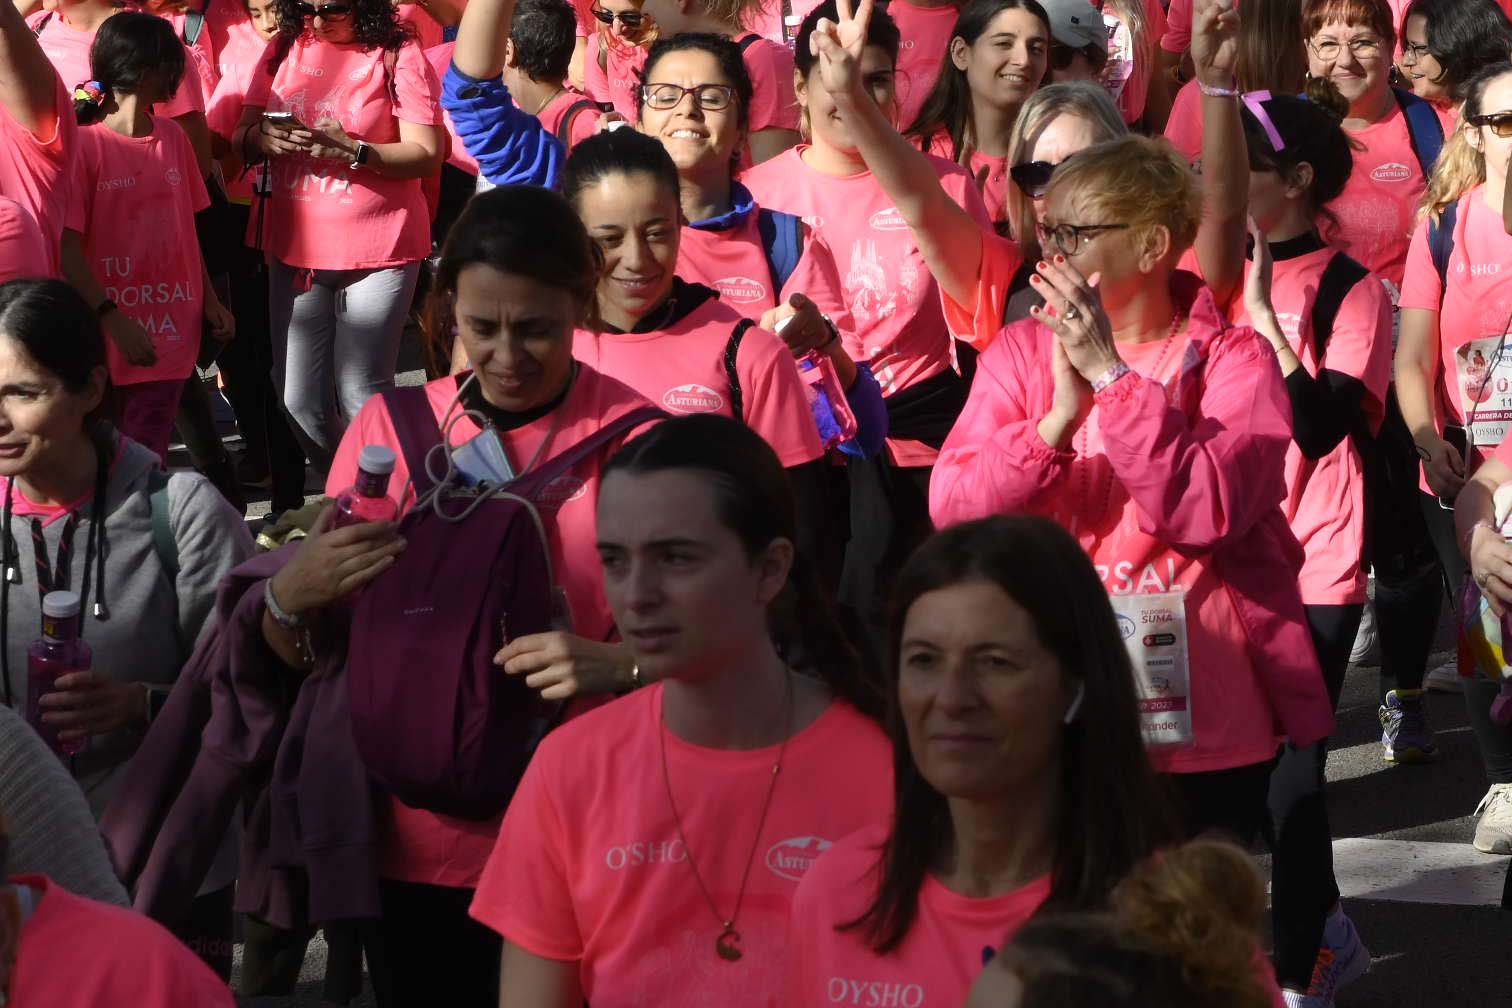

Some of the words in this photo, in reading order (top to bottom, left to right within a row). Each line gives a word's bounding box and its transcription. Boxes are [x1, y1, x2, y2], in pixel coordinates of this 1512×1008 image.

[1374, 170, 1410, 179] ASTURIANA
[101, 256, 132, 278] TU
[664, 392, 719, 407] ASTURIANA
[1142, 614, 1174, 624] SUMA
[828, 977, 925, 1008] OYSHO
